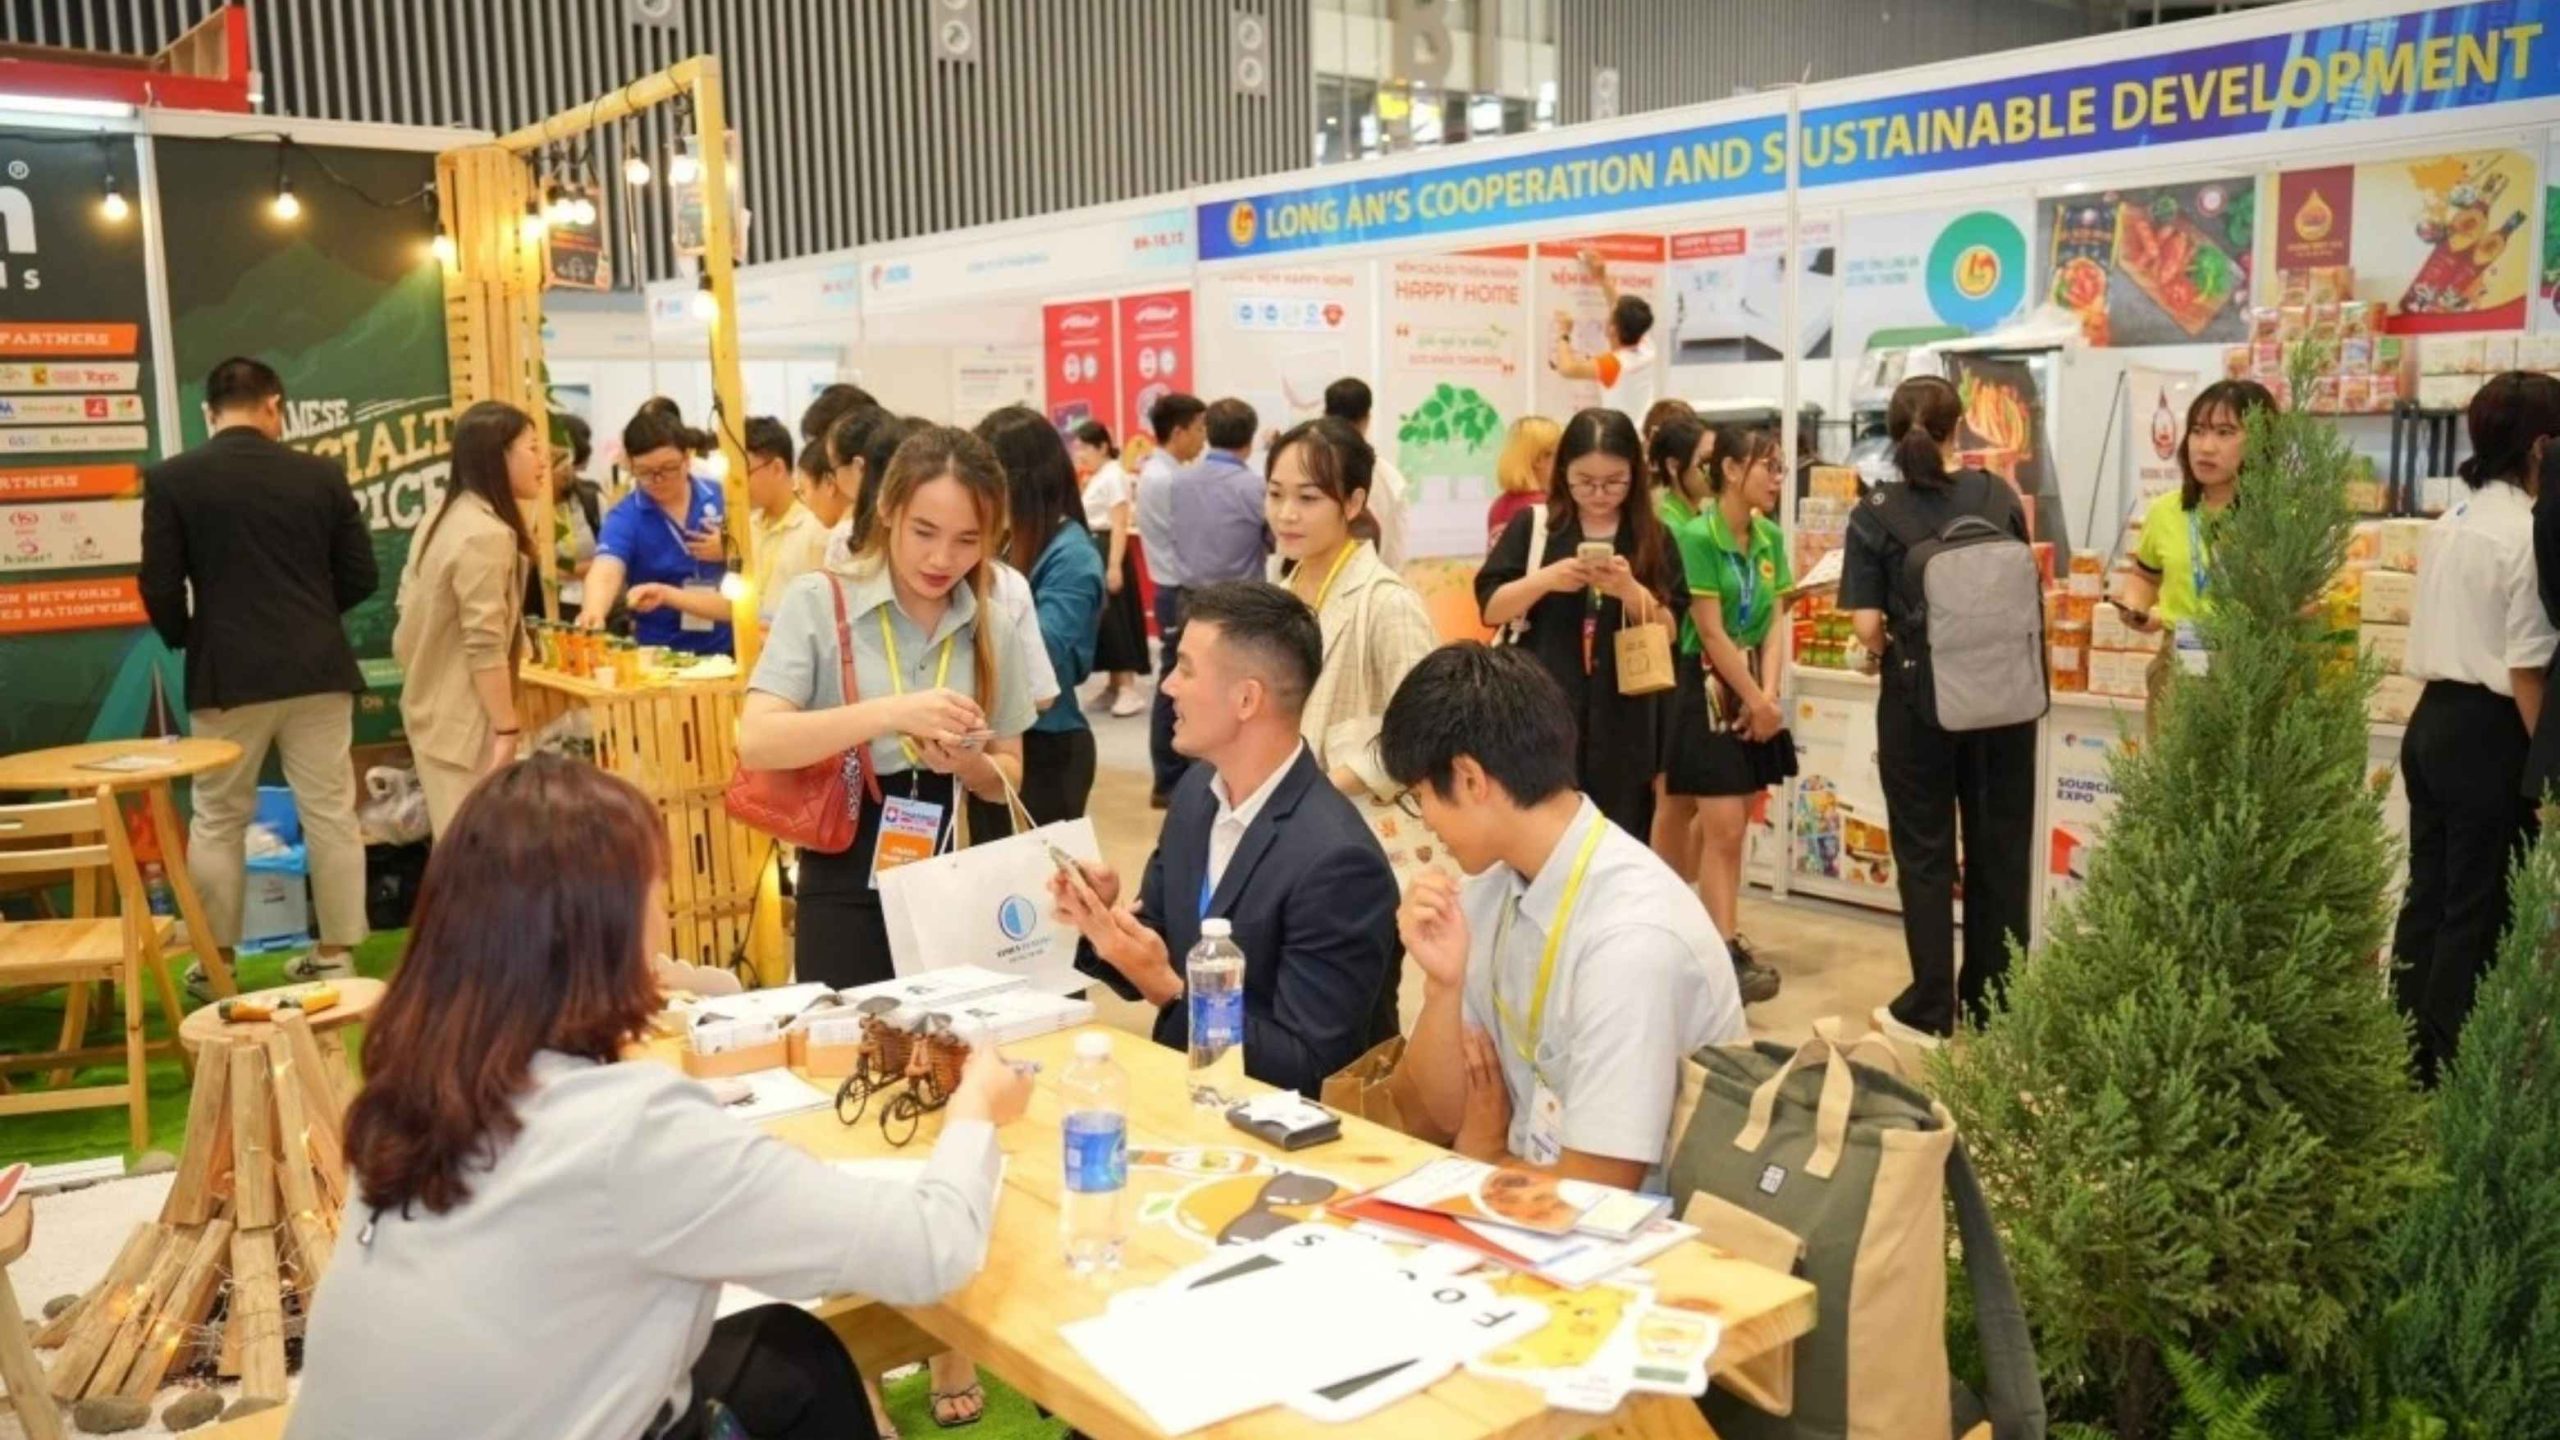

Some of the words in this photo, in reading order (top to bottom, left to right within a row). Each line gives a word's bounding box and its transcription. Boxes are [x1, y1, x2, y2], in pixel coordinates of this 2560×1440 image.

[1264, 199, 1339, 239] LONG
[1347, 188, 1411, 228] AN'S
[1418, 151, 1654, 218] COOPERATION
[1664, 138, 1751, 187] AND
[1762, 87, 2096, 174] SUSTAINABLE
[2112, 23, 2543, 131] DEVELOPMENT
[1396, 281, 1456, 300] HAPPY
[1464, 284, 1518, 303] HOME
[27, 587, 122, 603] NETWORKS
[2057, 789, 2094, 803] EXPO
